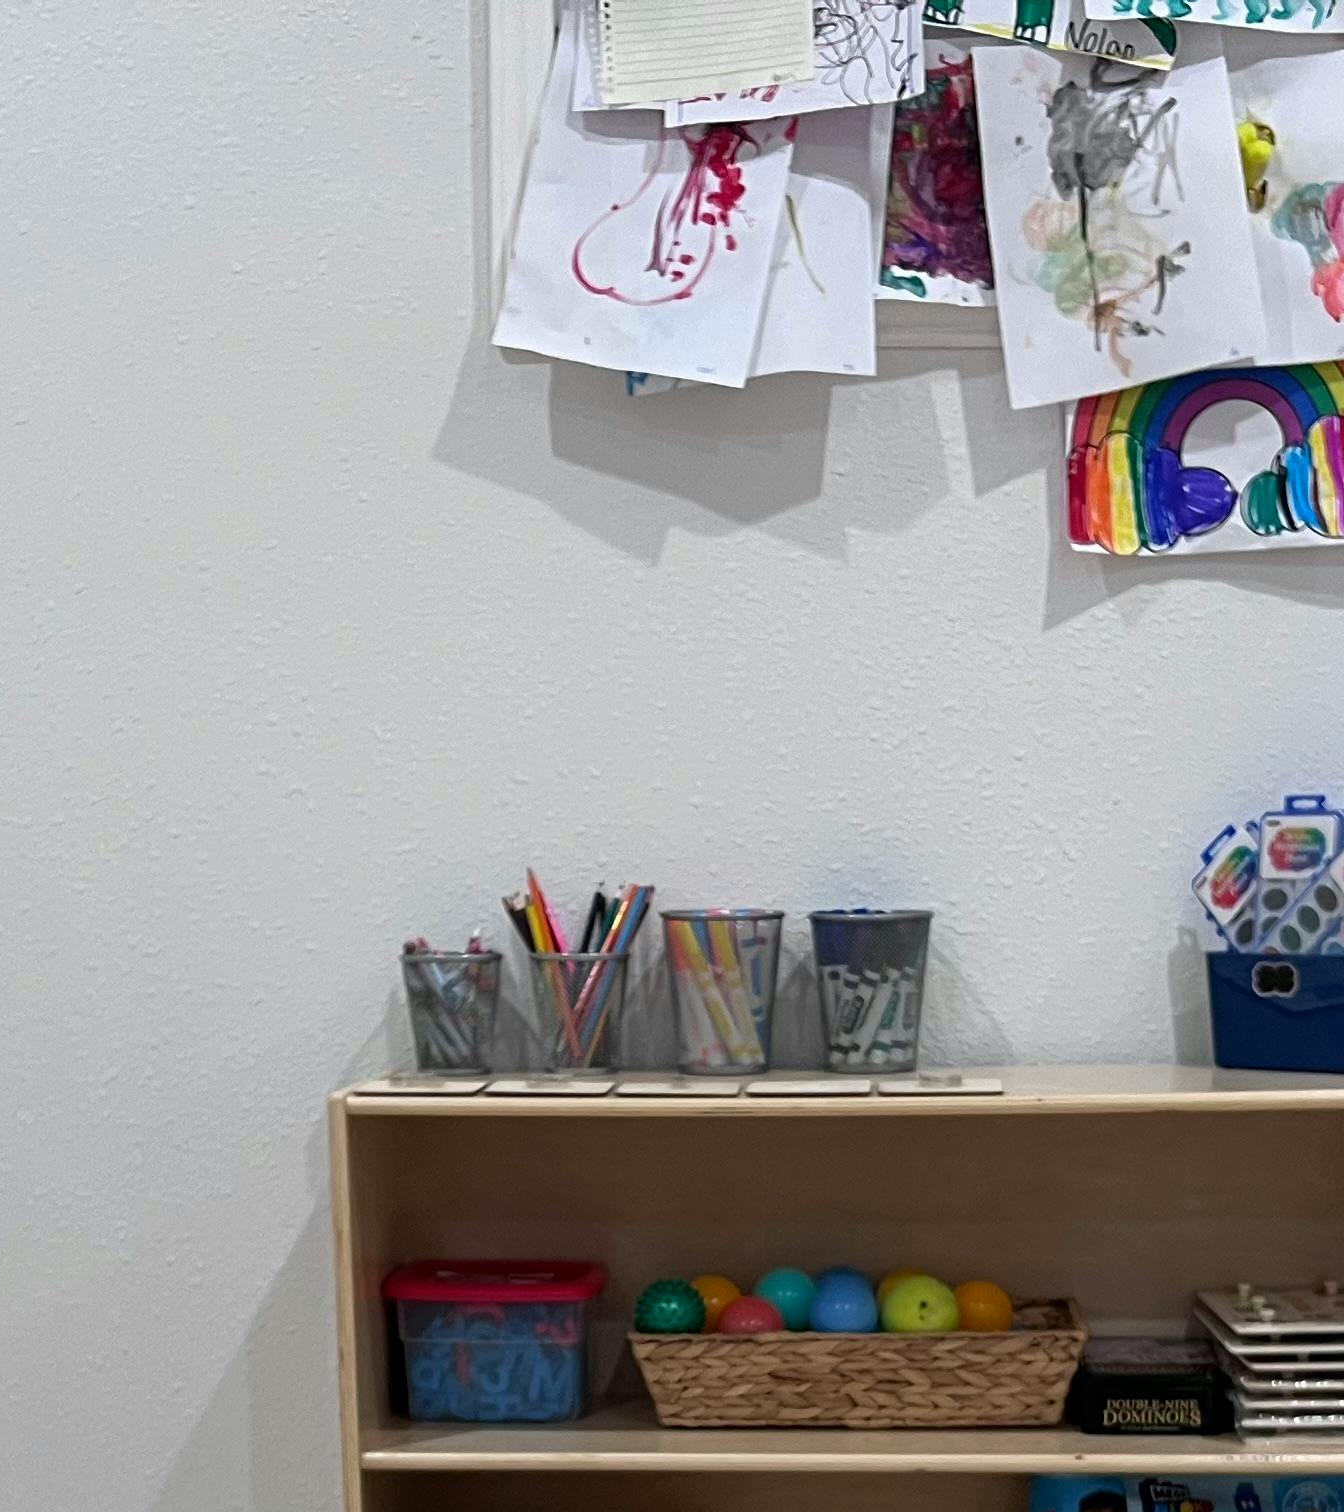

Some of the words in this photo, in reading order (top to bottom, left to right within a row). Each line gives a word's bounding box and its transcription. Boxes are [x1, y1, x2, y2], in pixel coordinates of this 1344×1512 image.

[1064, 18, 1135, 59] Nolan
[1106, 1398, 1199, 1410] DOUBLE-NINE
[1103, 1409, 1202, 1426] DOMINOES
